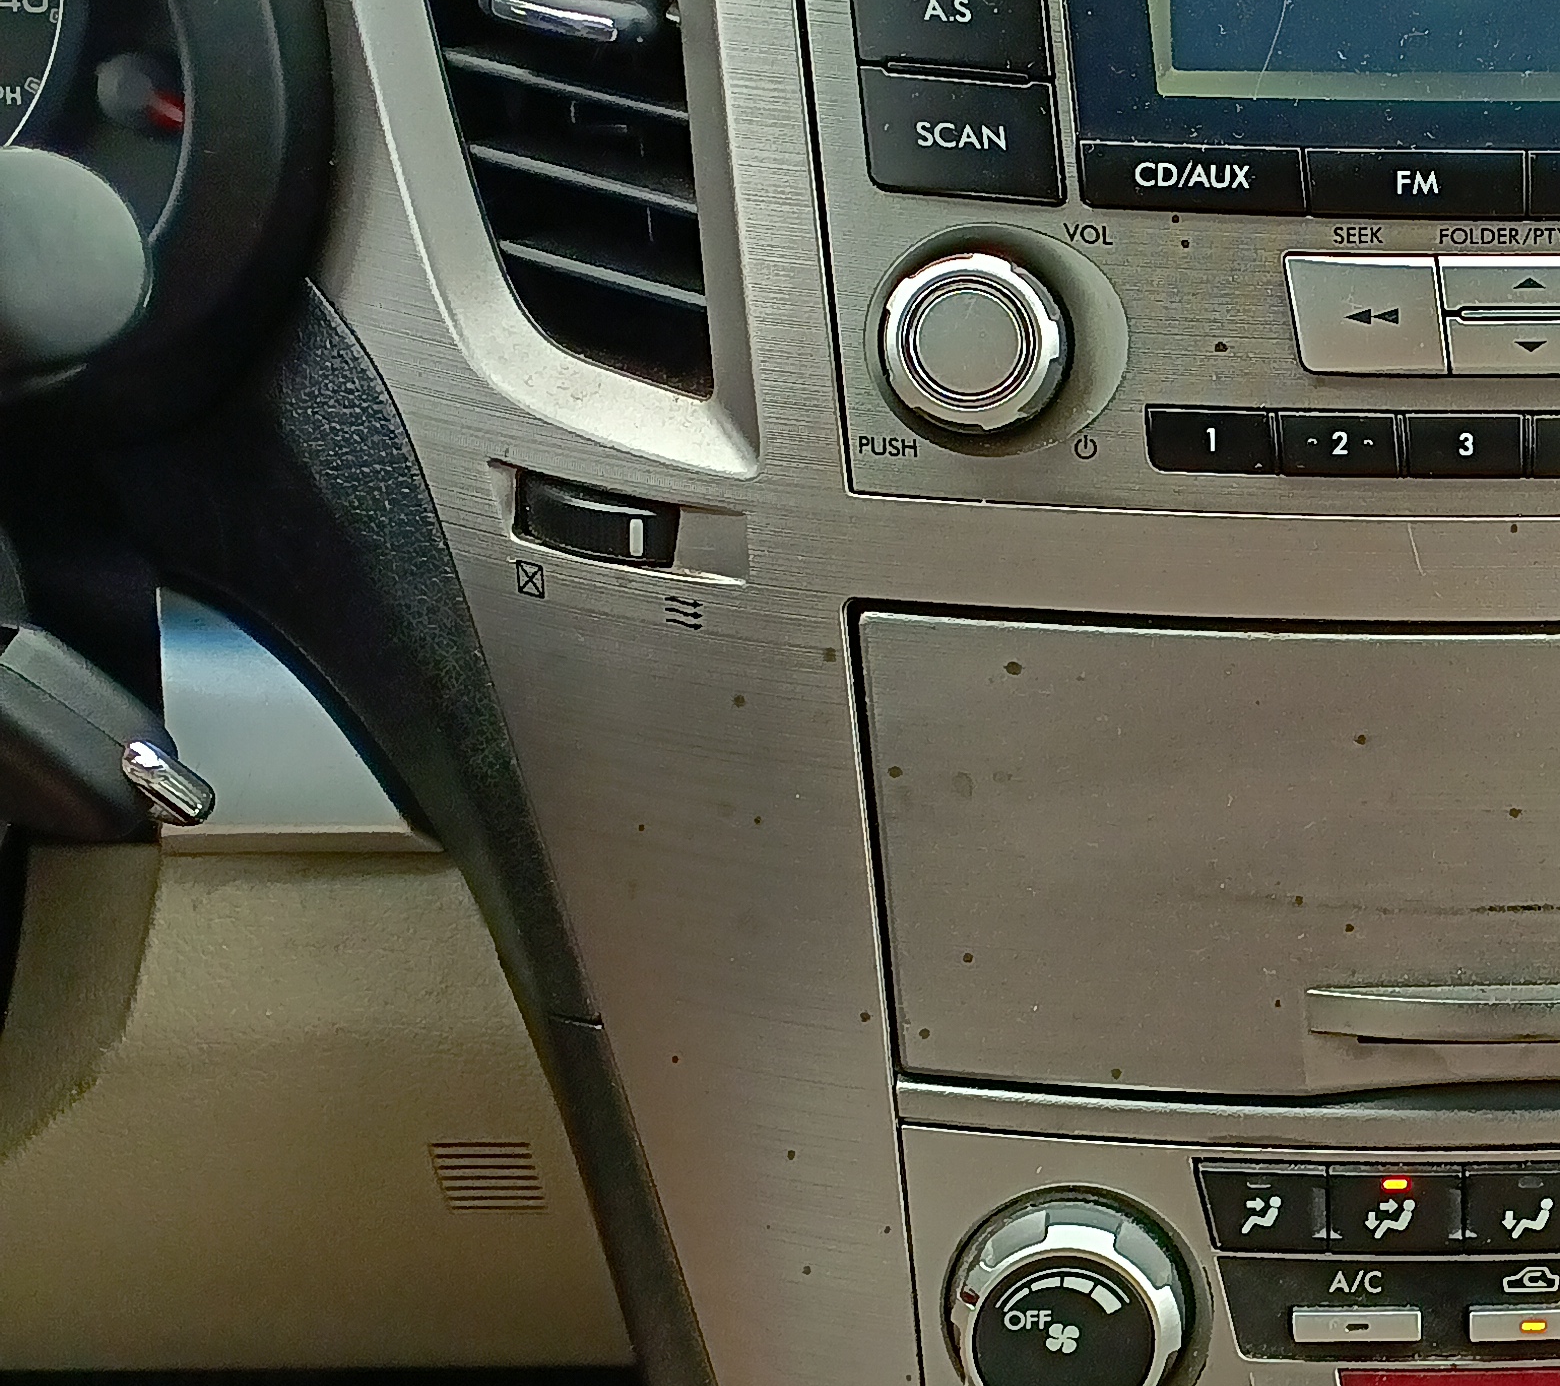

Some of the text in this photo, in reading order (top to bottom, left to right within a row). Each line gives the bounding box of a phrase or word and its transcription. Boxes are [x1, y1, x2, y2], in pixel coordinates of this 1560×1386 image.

[915, 121, 1007, 151] SCAN
[1134, 159, 1250, 189] CD/AUX
[1396, 170, 1439, 195] FM
[1062, 223, 1114, 246] VOL
[1332, 226, 1384, 246] SEEK
[858, 436, 918, 458] PUSH
[1206, 427, 1216, 452] 1
[1331, 431, 1349, 455] 2
[1458, 432, 1474, 456] 3
[1328, 1269, 1382, 1294] A/C
[1003, 1310, 1053, 1331] OFF
